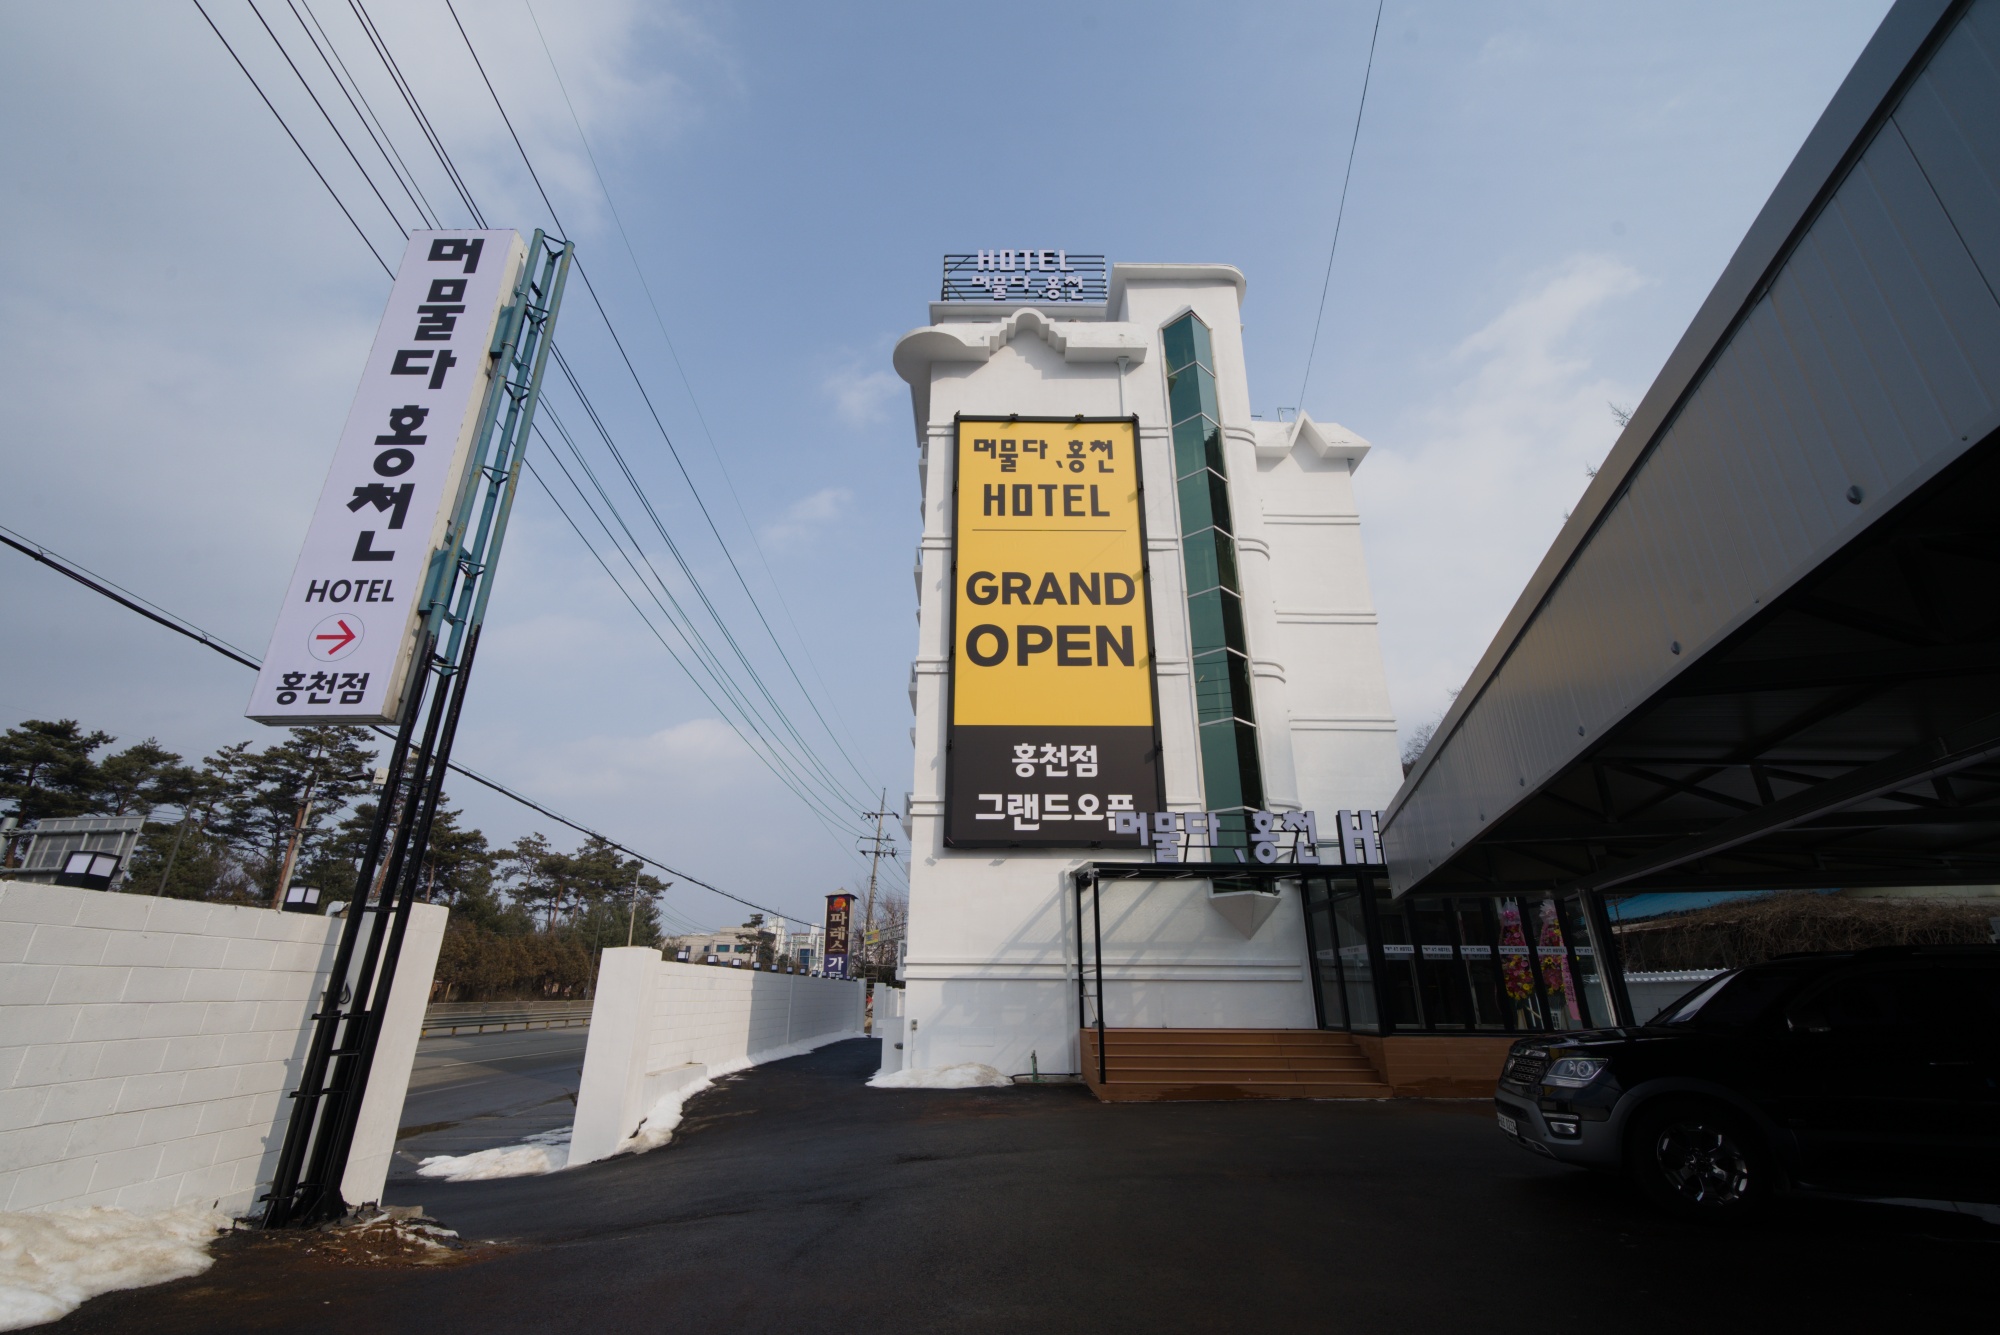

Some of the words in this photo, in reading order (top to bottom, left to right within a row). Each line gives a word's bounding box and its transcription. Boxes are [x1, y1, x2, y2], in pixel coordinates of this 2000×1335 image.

[978, 249, 1074, 272] HOTEL
[390, 238, 485, 390] 머물다
[346, 404, 430, 562] 홍천
[983, 483, 1111, 517] HOTEL
[304, 579, 395, 603] HOTEL
[965, 570, 1136, 606] GRAND
[965, 623, 1136, 668] OPEN
[275, 671, 370, 706] 홍천점
[1011, 742, 1098, 778] 홍천점
[1338, 809, 1387, 865] H
[828, 911, 848, 952] 파레스
